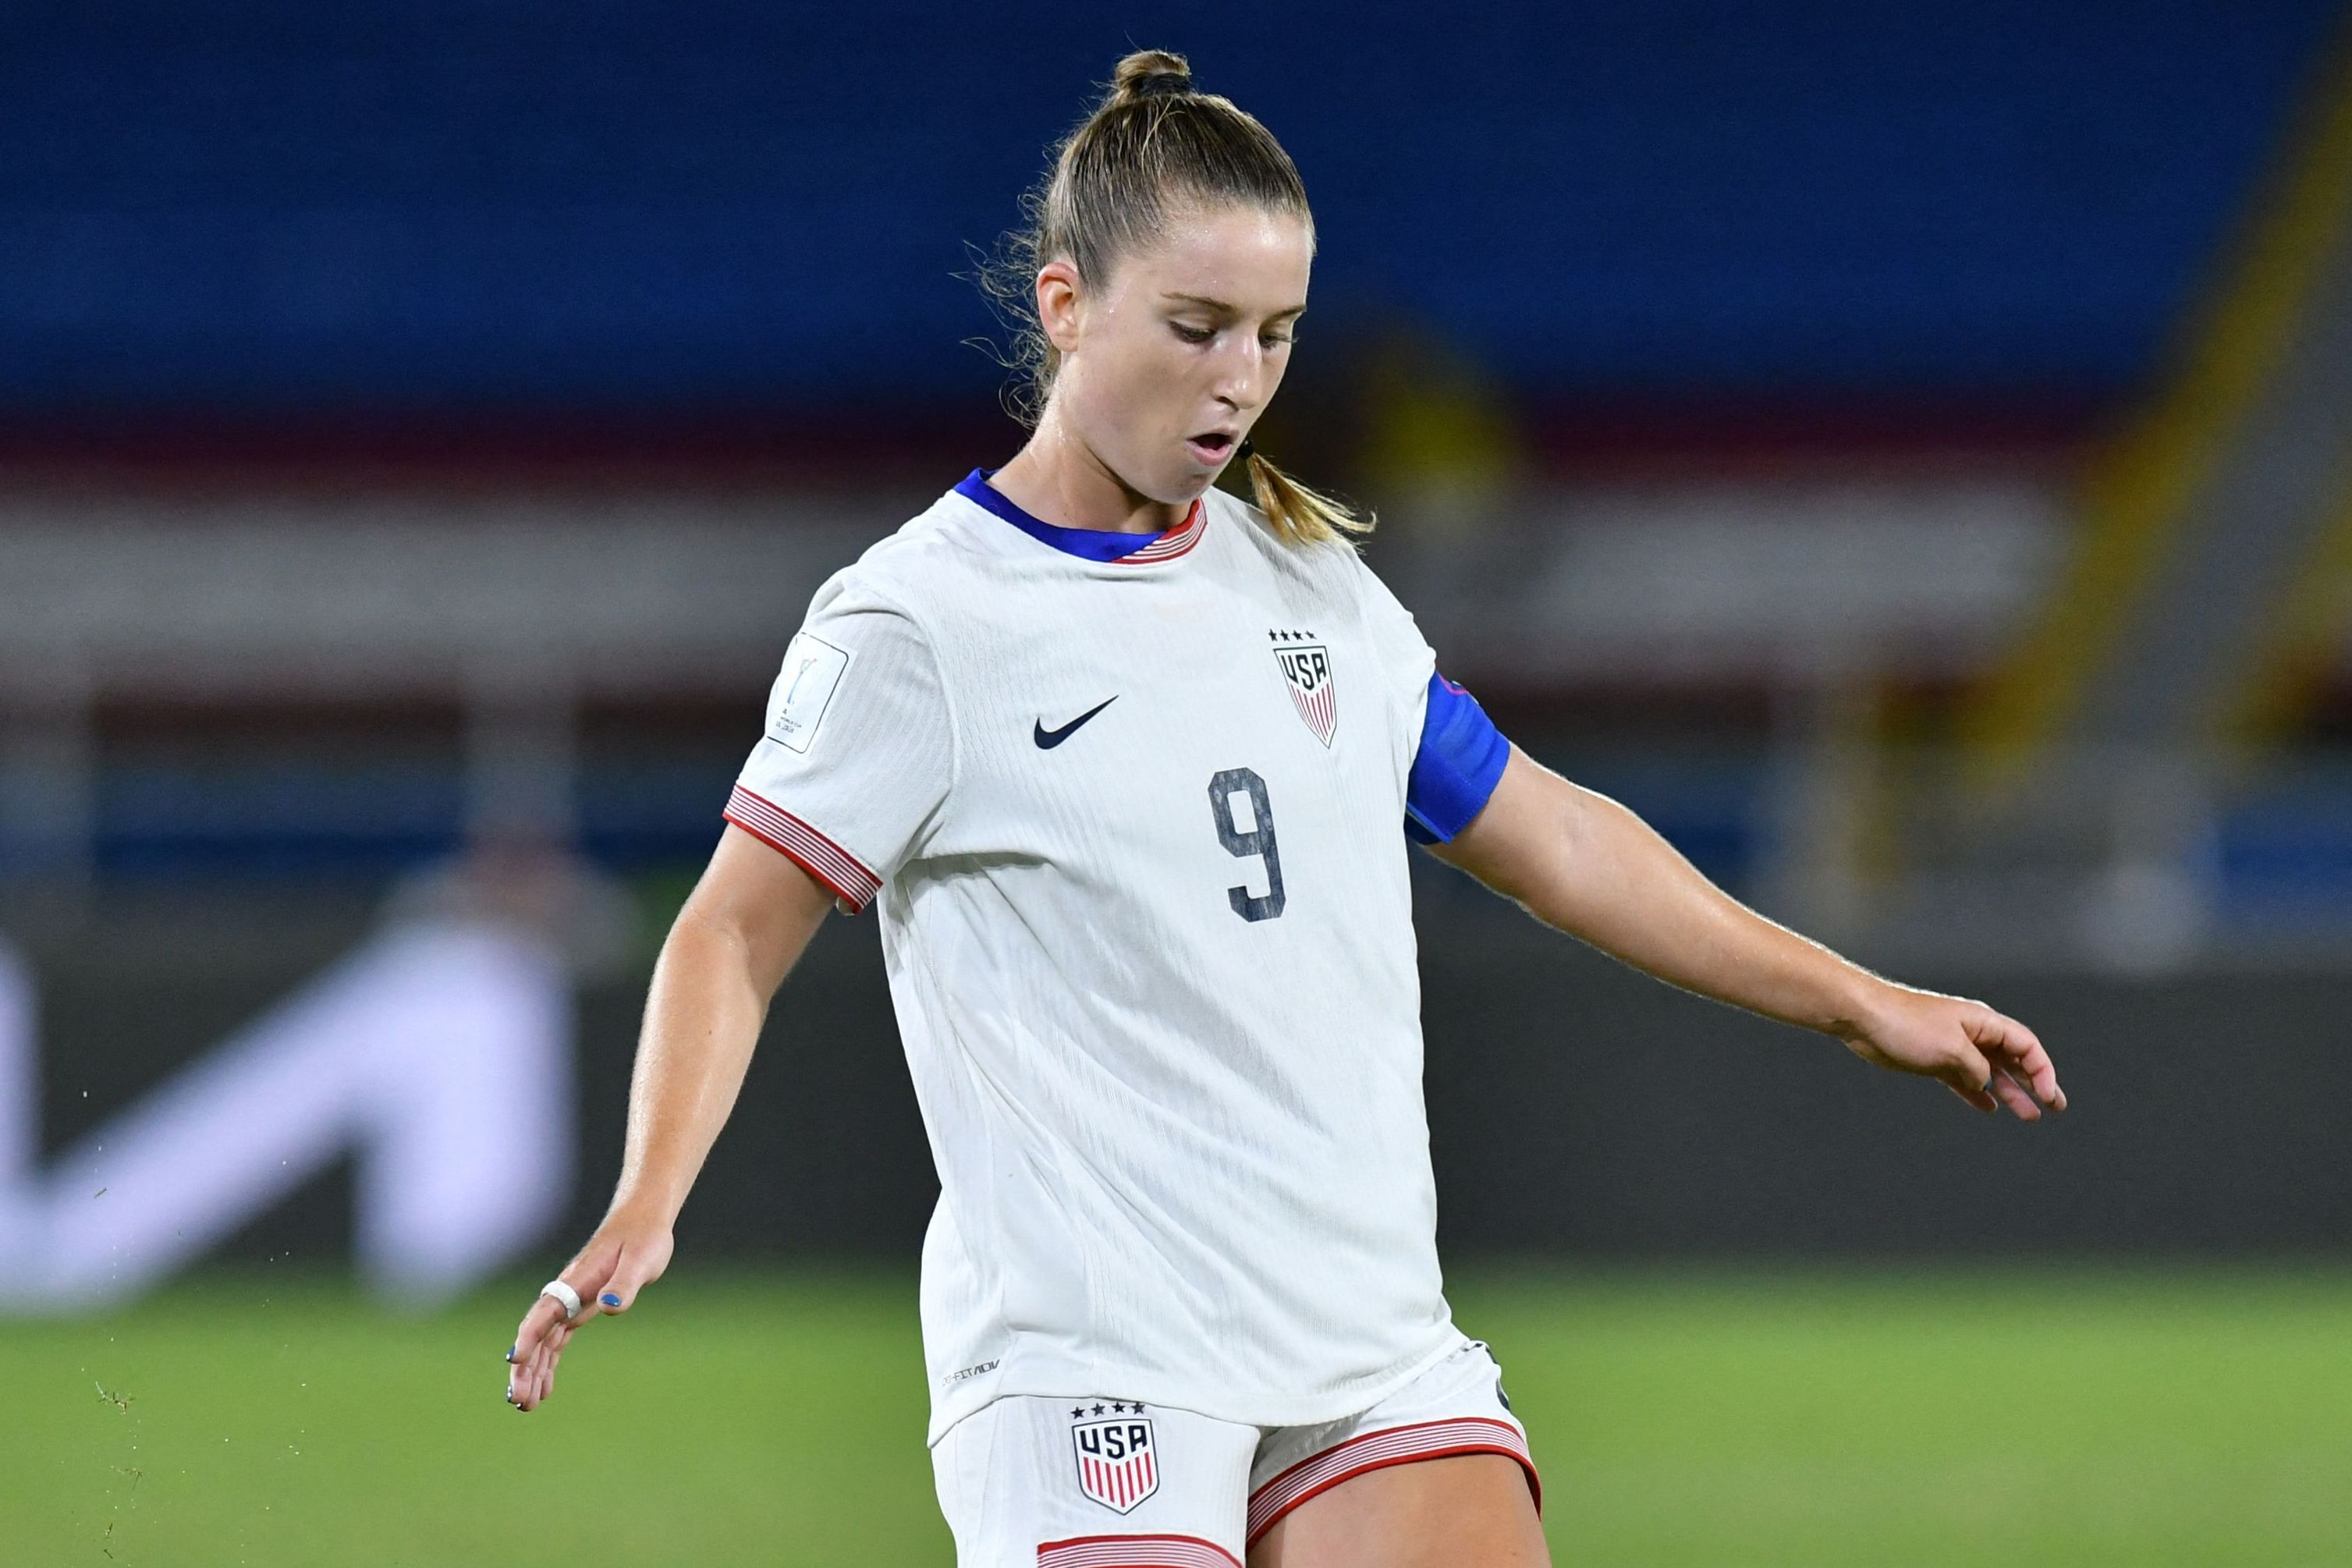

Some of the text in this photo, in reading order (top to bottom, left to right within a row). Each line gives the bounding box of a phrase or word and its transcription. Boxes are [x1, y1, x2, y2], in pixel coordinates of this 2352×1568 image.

[1281, 653, 1327, 691] USA
[1208, 767, 1286, 923] 9
[1080, 1424, 1148, 1460] USA
